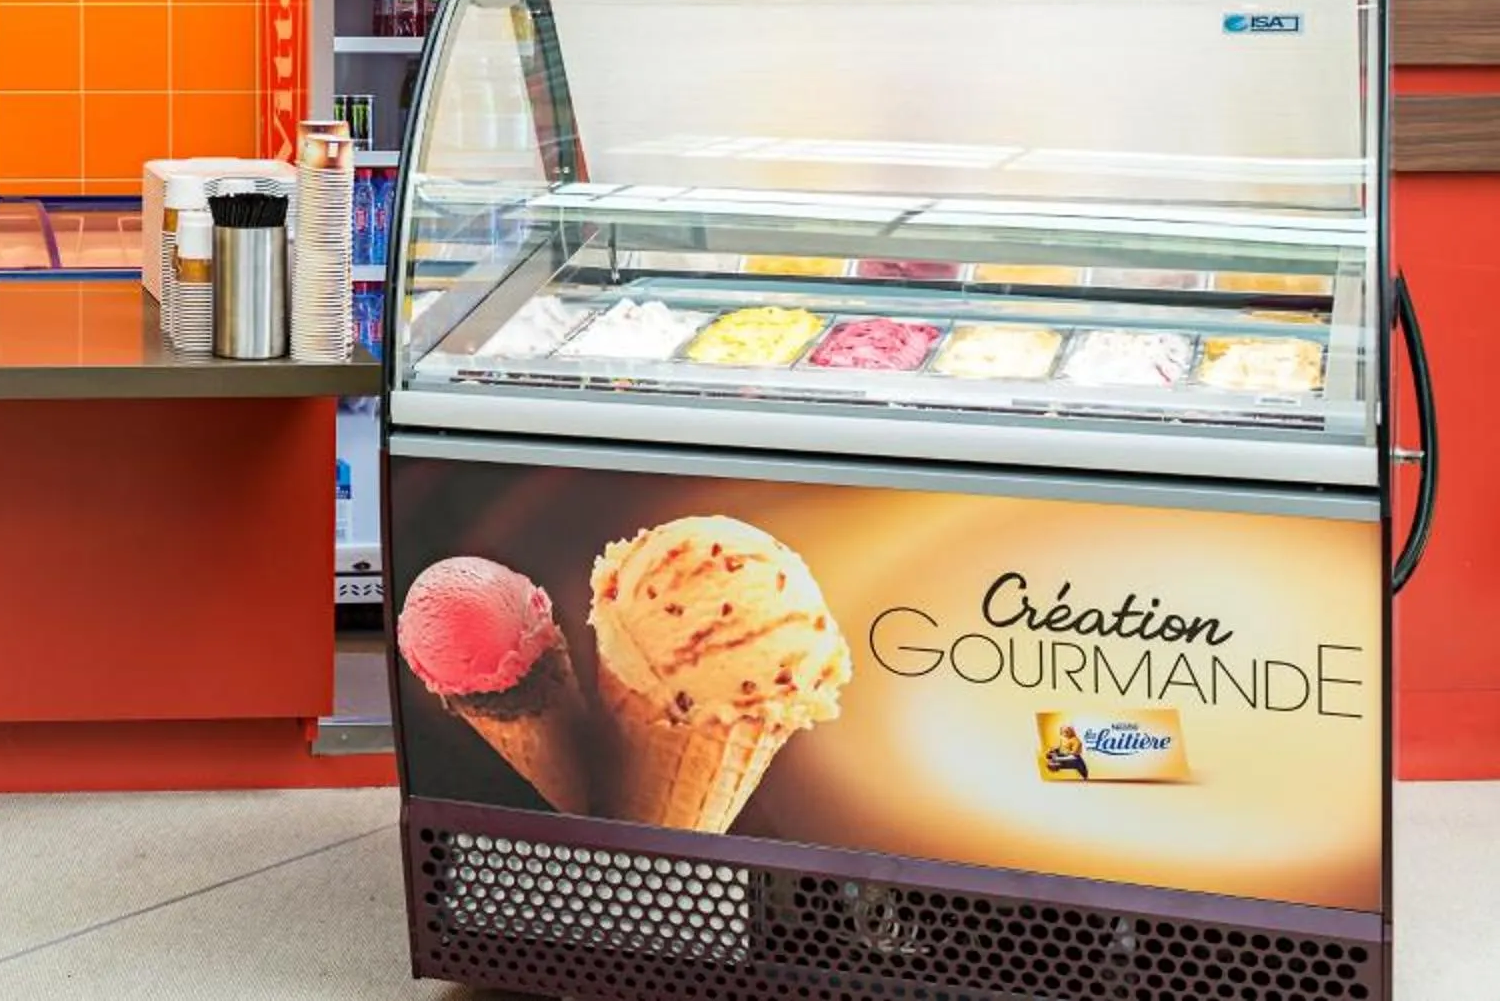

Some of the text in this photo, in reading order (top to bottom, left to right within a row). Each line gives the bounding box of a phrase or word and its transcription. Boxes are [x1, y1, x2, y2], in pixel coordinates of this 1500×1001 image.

[1251, 15, 1284, 28] ISA
[982, 572, 1234, 646] Création
[869, 606, 1363, 719] GOURMANDE
[1094, 728, 1172, 751] Laitière
